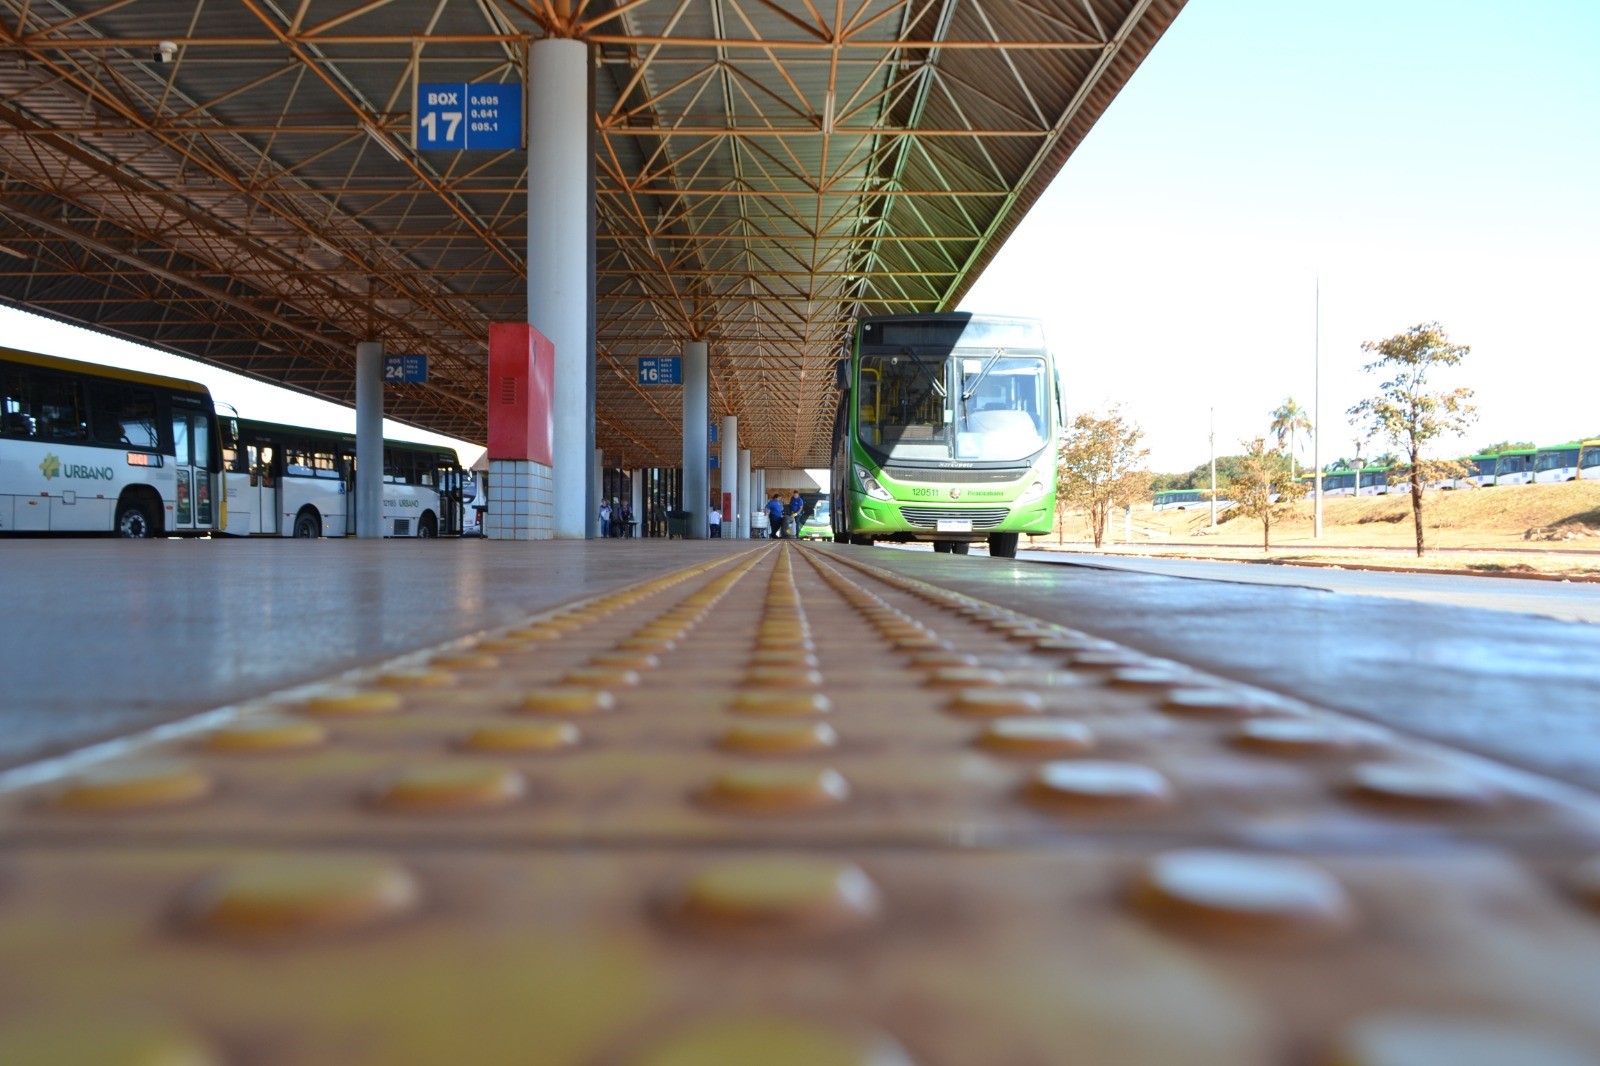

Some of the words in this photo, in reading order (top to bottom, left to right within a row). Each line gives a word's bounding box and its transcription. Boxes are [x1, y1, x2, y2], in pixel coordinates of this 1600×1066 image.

[428, 92, 458, 106] BOX
[470, 96, 499, 106] 0.605
[470, 109, 498, 119] 0.641
[421, 111, 463, 142] 17
[471, 122, 498, 132] 605.1
[386, 366, 404, 378] 24
[640, 368, 658, 381] 16
[63, 463, 114, 481] URBANO
[912, 487, 939, 497] 120511
[398, 499, 419, 509] URBANO
